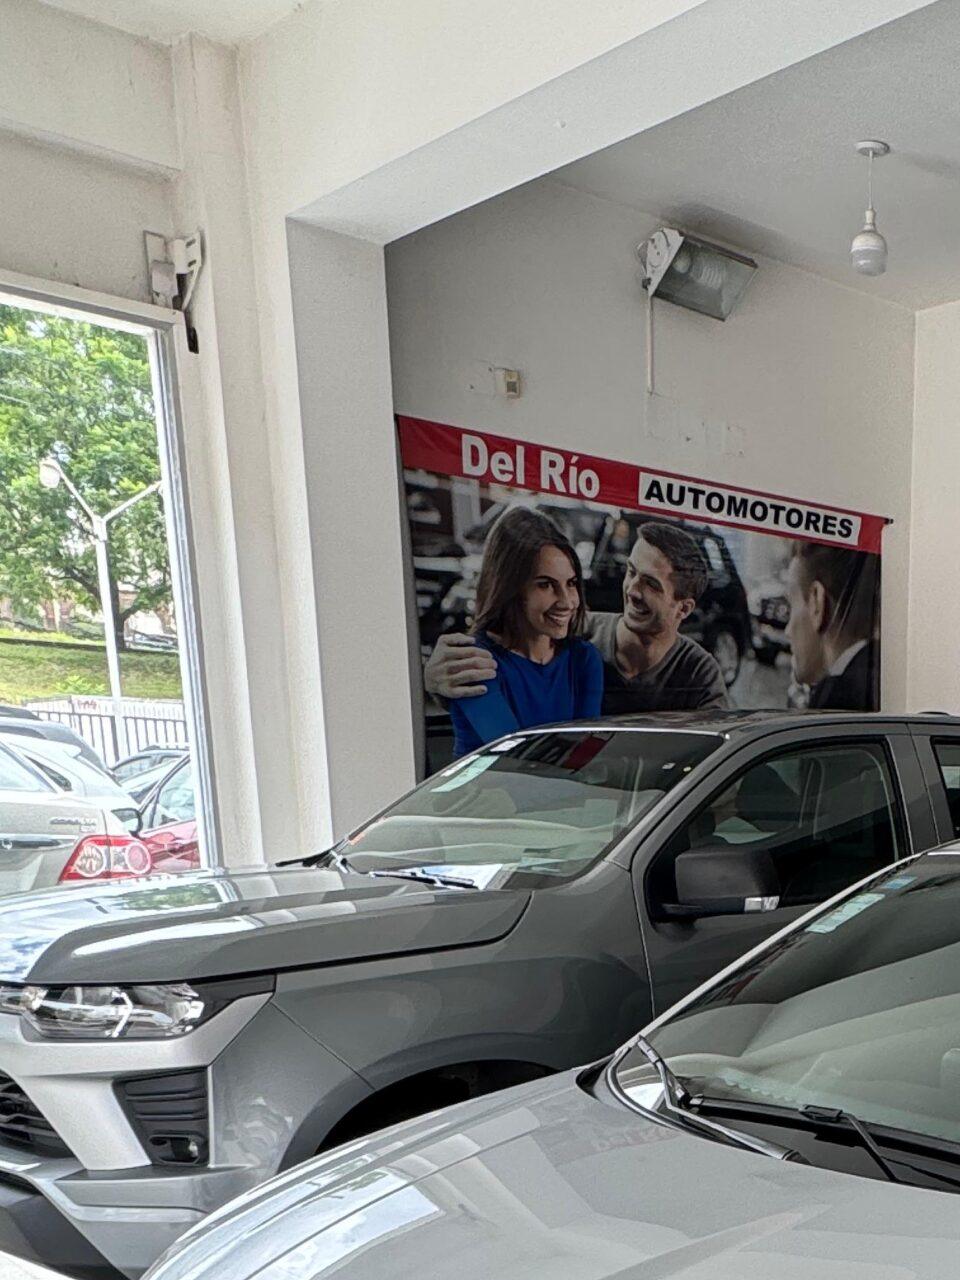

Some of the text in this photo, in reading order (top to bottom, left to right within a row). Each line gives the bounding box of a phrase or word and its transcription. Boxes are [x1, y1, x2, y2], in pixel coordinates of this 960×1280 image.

[461, 433, 601, 499] Del Río
[644, 479, 854, 539] AUTOMOTORES
